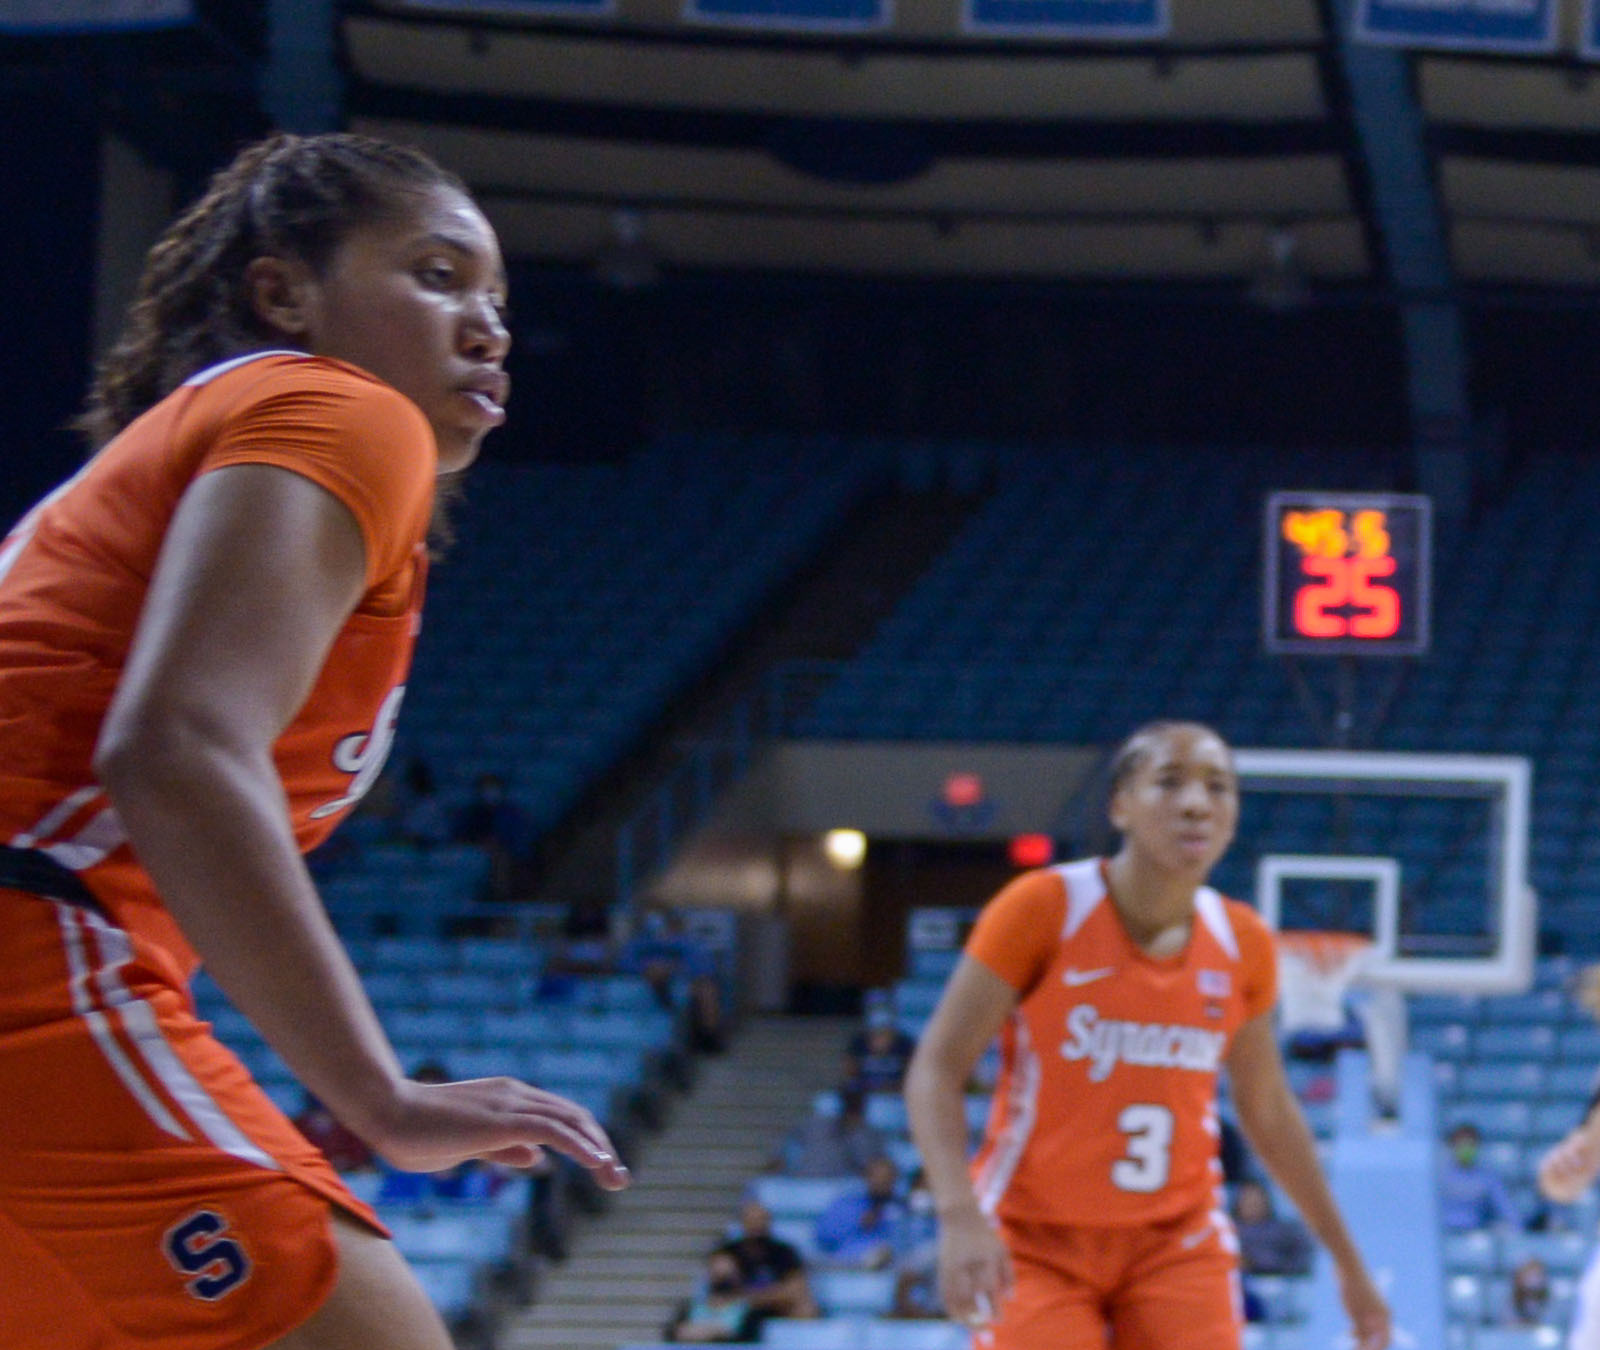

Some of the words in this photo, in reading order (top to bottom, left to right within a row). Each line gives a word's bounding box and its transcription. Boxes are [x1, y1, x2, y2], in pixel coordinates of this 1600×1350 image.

[1294, 555, 1401, 639] 25
[1111, 1103, 1173, 1192] 3
[162, 1210, 253, 1301] S
